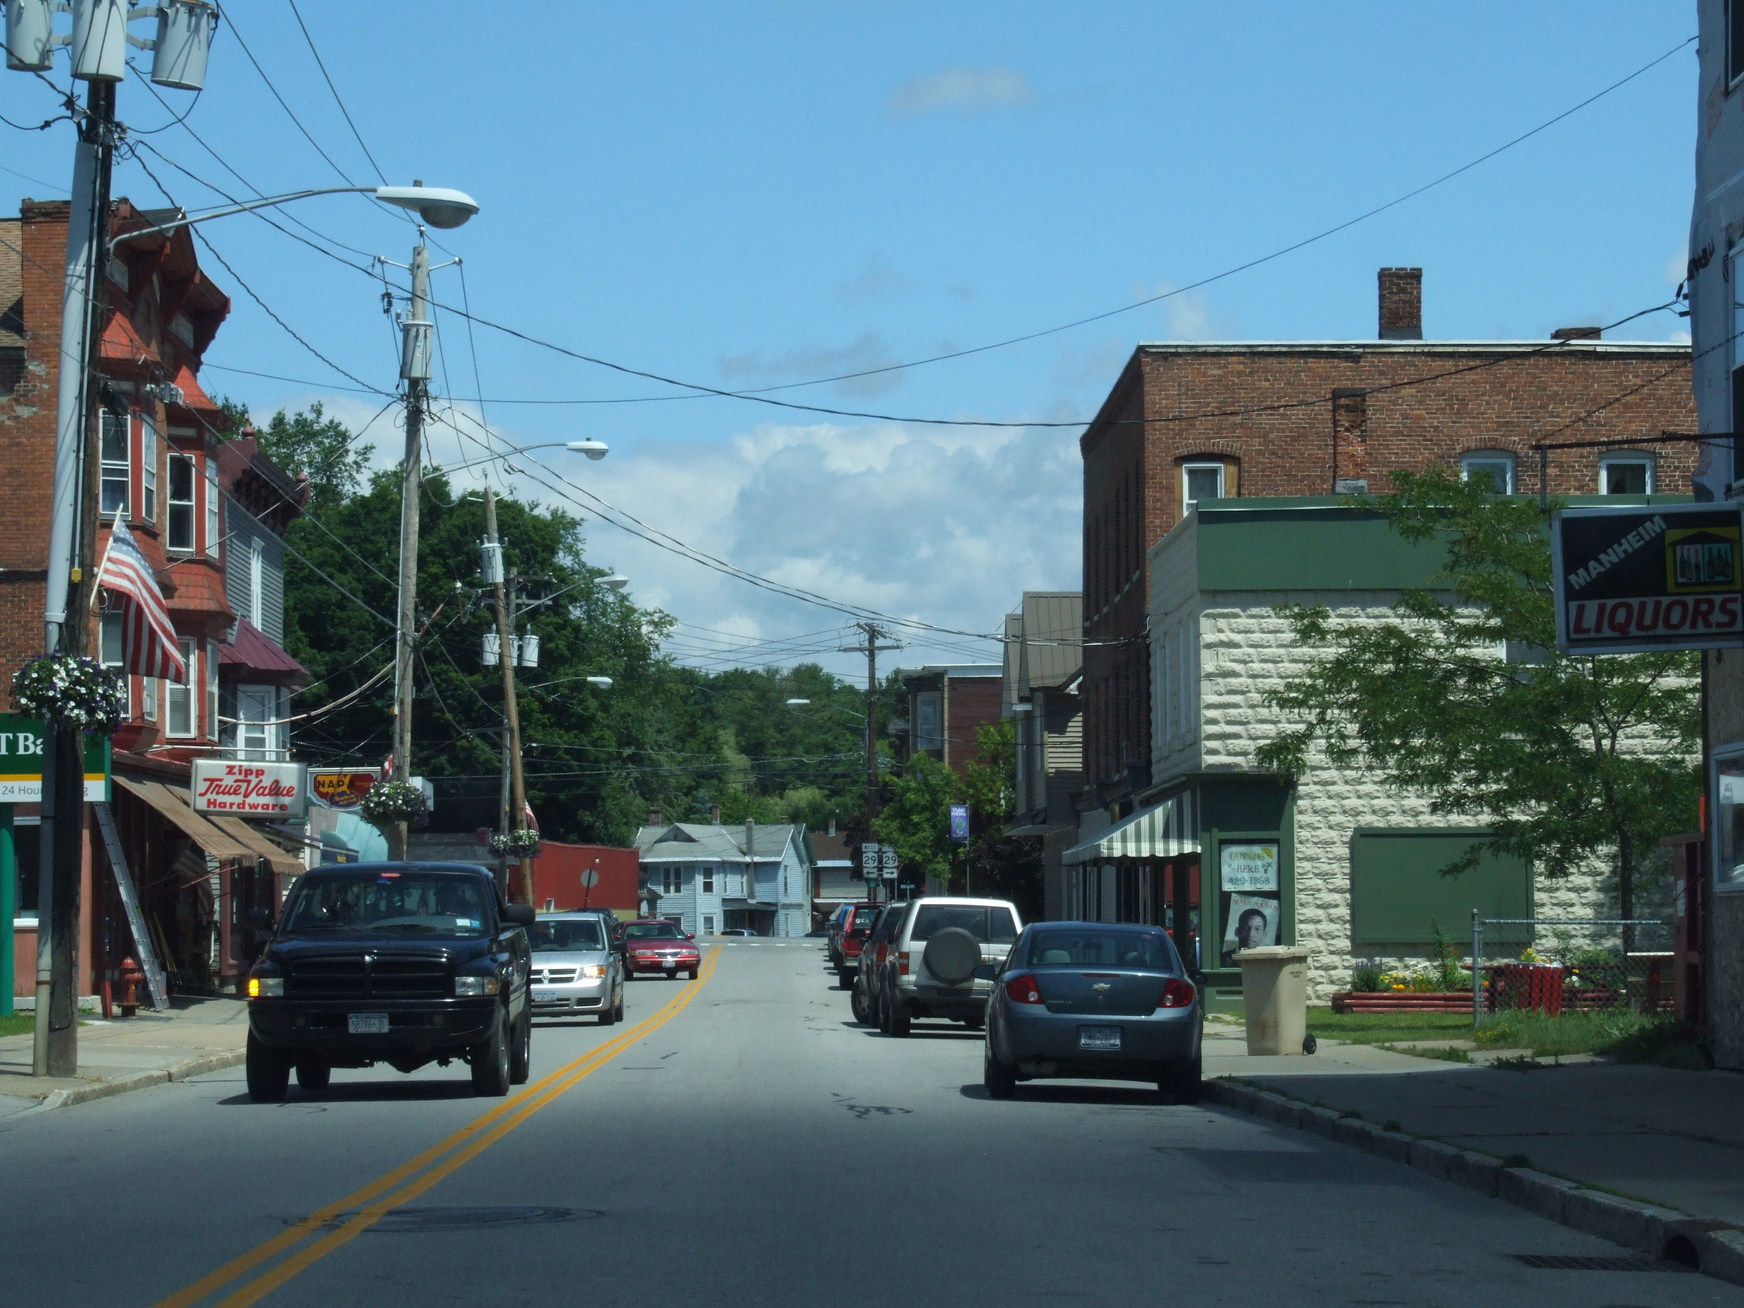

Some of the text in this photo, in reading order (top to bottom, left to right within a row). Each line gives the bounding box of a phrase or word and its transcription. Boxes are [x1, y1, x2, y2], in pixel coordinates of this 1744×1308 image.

[1568, 515, 1667, 590] MANHEIM
[1572, 597, 1738, 636] LIQUORS
[225, 765, 265, 778] Zipp
[2, 786, 15, 795] 24
[206, 798, 289, 812] Hardware
[864, 855, 876, 865] 29
[884, 855, 897, 865] 29
[1236, 864, 1260, 873] HERE
